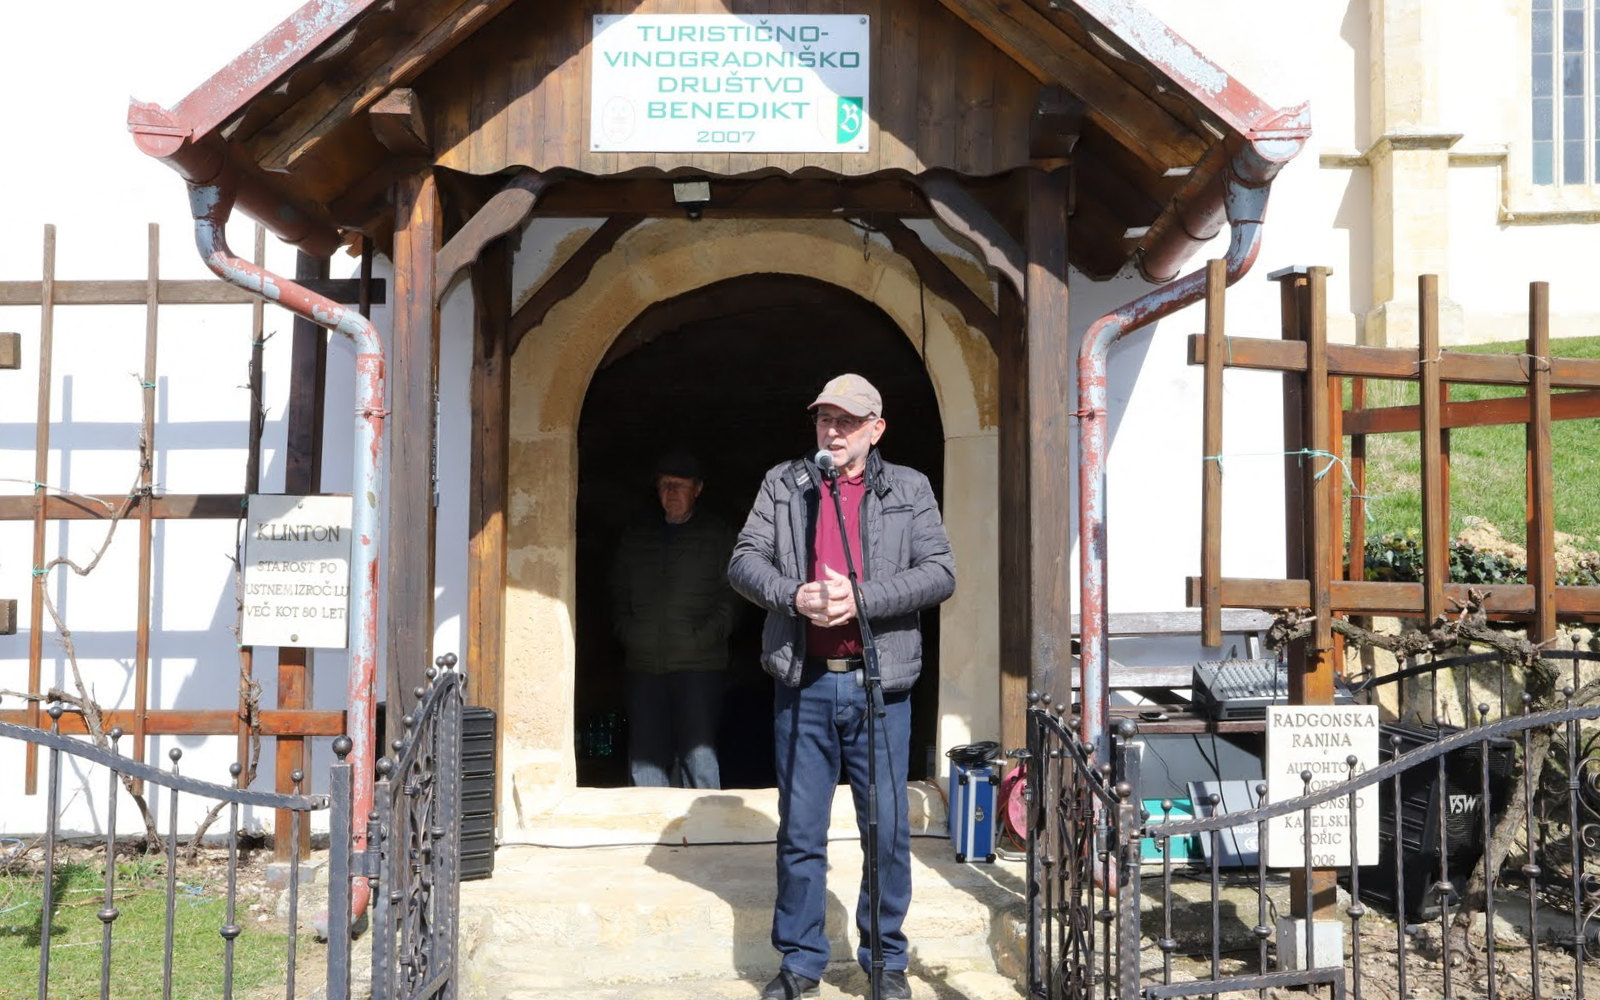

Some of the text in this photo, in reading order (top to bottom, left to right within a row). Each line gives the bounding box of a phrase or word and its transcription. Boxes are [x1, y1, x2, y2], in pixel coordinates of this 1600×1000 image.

[637, 19, 829, 42] TURISTIČNO-
[604, 45, 860, 68] VINOGRADNIŠKO
[658, 71, 803, 93] DRUŠTVO
[647, 101, 811, 119] BENEDIKT
[697, 131, 755, 144] 2007
[256, 522, 340, 542] KLINTON
[256, 561, 338, 574] STAROST PO
[246, 601, 271, 618] VEČ
[275, 606, 300, 618] KOT
[322, 607, 346, 620] LET
[1273, 713, 1376, 728] RADGONSKA
[1292, 733, 1352, 748] RANINA
[1286, 761, 1367, 775] AUTOHTOA
[1309, 854, 1336, 867] 006
